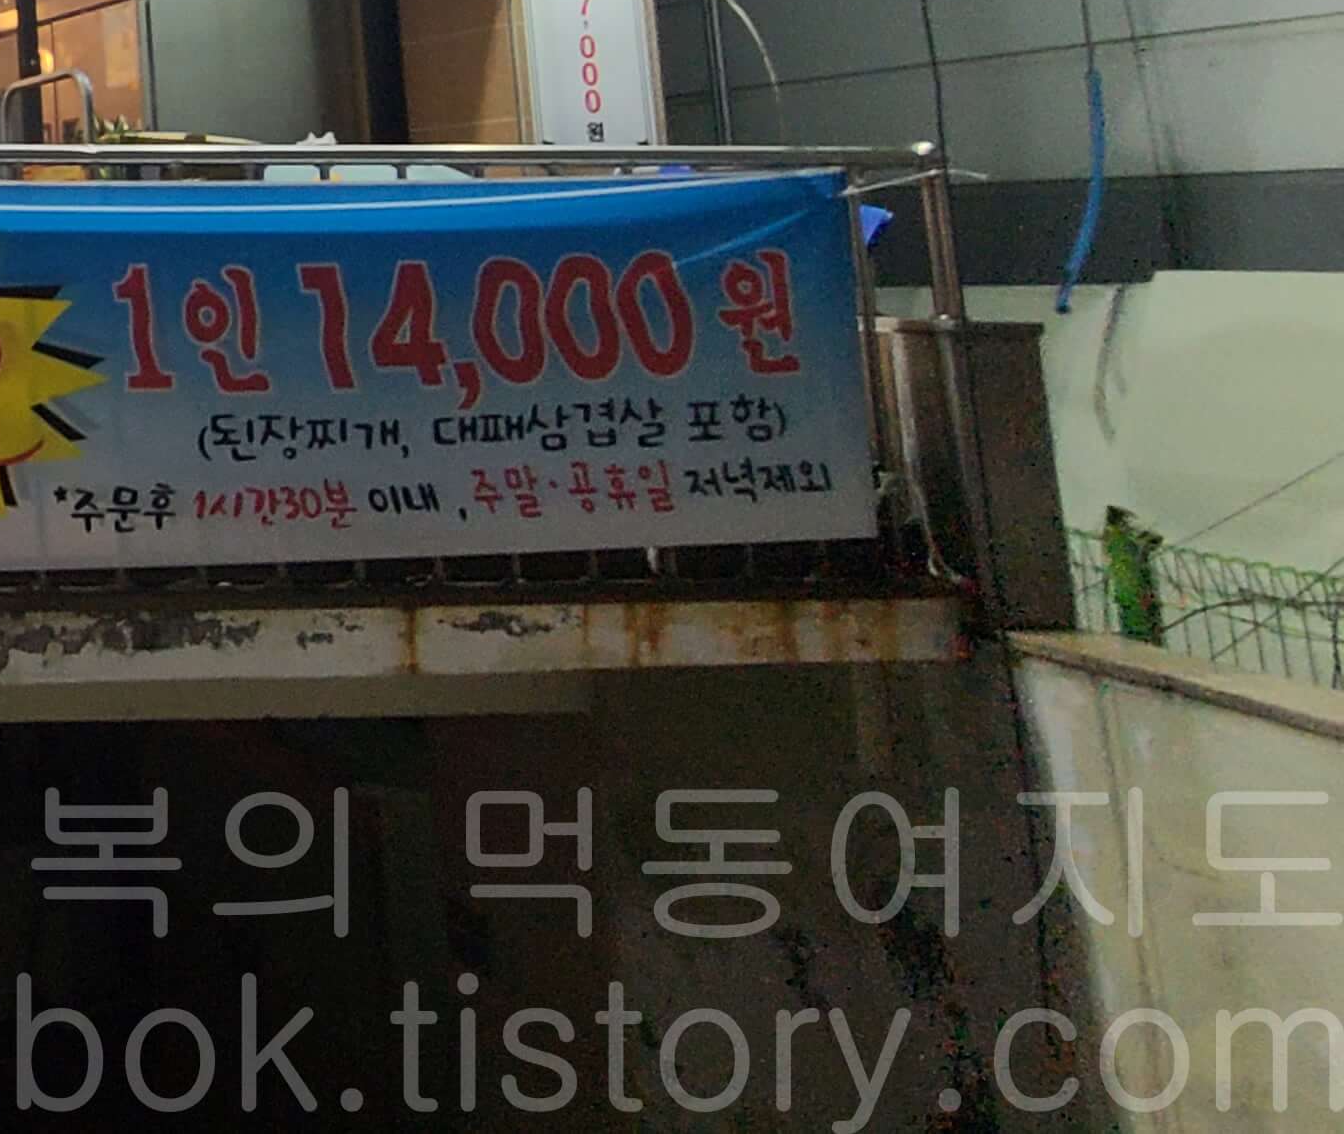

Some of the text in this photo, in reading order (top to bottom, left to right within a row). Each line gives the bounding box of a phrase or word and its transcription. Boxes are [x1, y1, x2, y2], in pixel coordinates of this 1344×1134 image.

[114, 264, 271, 394] 1인
[432, 396, 668, 452] 대패삼겹살
[688, 392, 788, 444] 포함)
[193, 478, 358, 529] 1시간30분
[683, 457, 833, 504] 저녁제외
